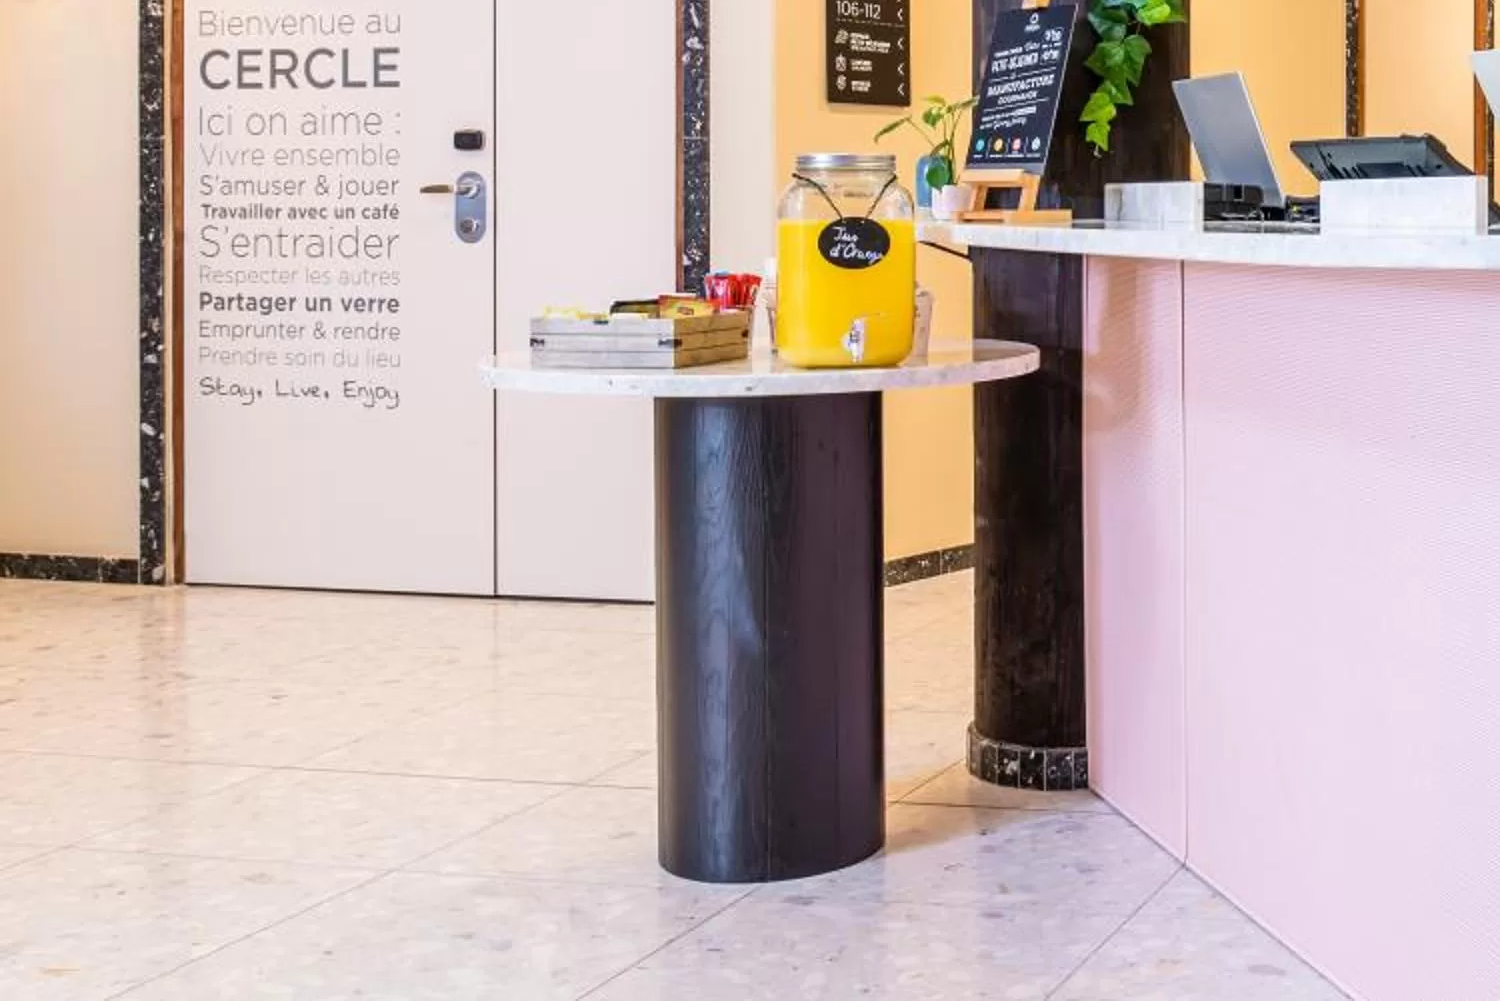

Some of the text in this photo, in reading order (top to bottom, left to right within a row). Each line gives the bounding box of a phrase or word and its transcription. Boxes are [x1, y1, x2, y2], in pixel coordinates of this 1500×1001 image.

[836, 0, 881, 20] 106-112
[198, 10, 401, 37] Bienvenue au
[199, 46, 401, 90] CERCLE
[198, 104, 233, 136] Ici
[245, 112, 288, 136] on
[300, 104, 383, 136] aime
[200, 142, 400, 167] Vivre ensemble
[200, 173, 400, 200] S'amuser & jouer
[200, 202, 400, 221] Travailler avec un café
[200, 224, 400, 259] S'entraider
[199, 265, 401, 287] Respecter les autres
[199, 291, 400, 316] Partager un verre
[198, 319, 401, 342] Emprunter & rendre
[199, 346, 401, 369] Prendre soin du lieu
[342, 379, 400, 410] Enjoy
